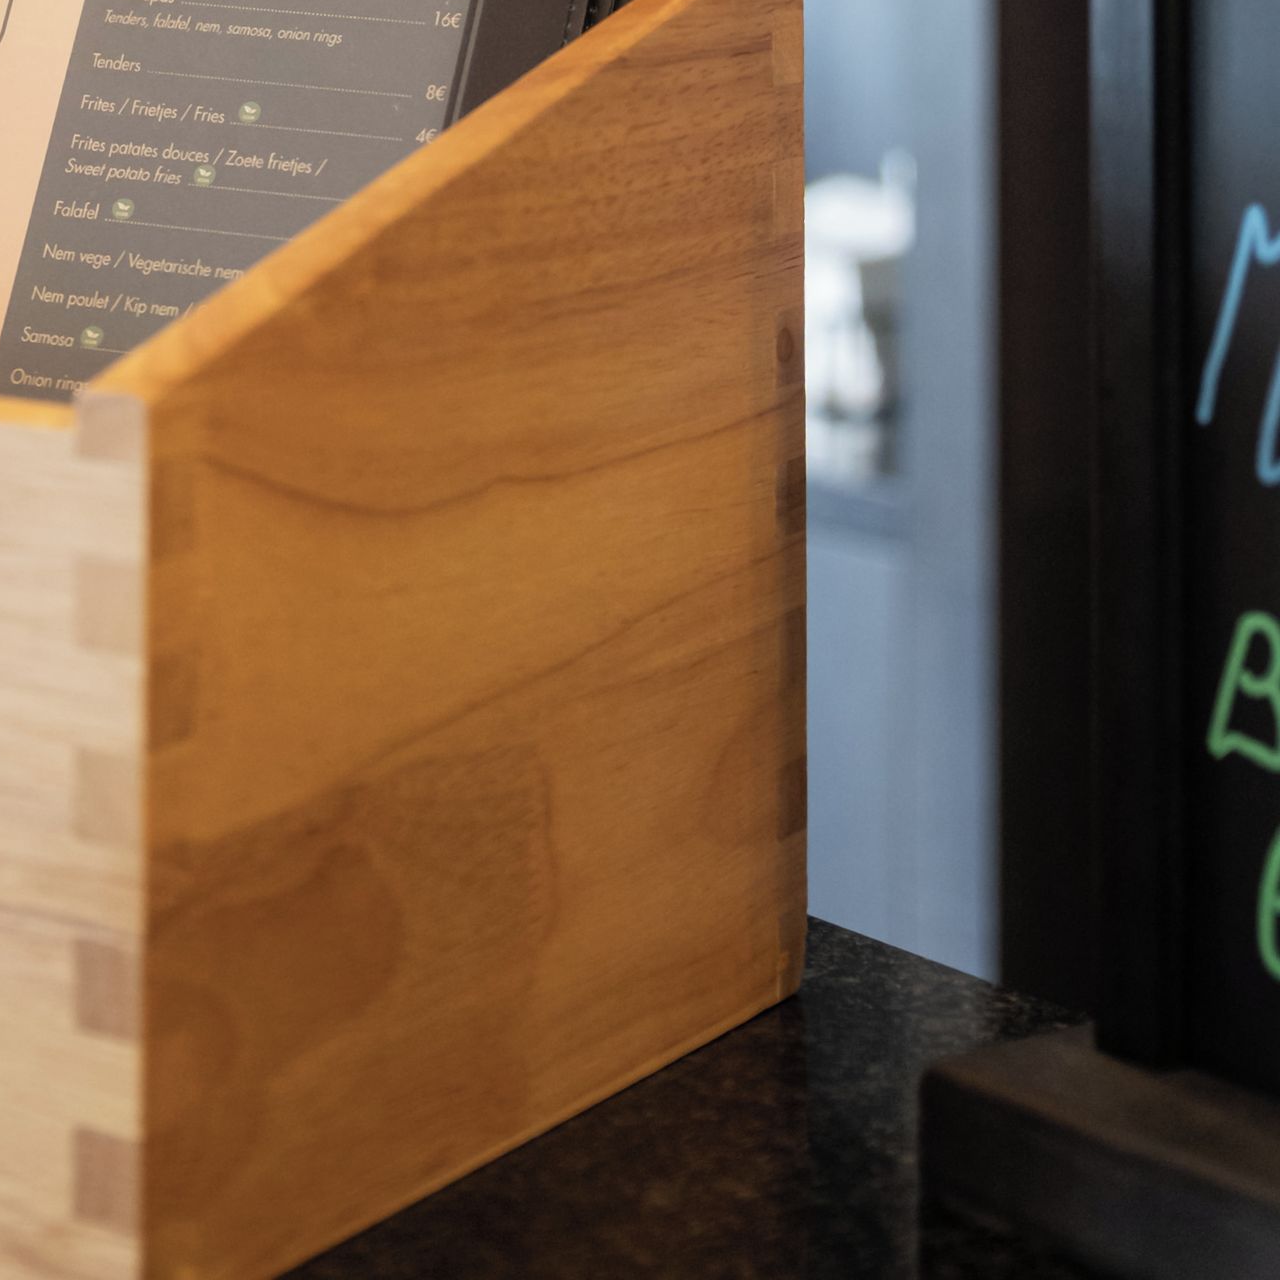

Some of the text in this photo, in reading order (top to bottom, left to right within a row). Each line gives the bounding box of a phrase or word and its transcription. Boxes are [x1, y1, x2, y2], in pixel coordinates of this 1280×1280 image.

[104, 10, 149, 28] Tenders,
[153, 13, 192, 33] falafel,
[227, 23, 273, 40] samosa,
[277, 26, 310, 42] onion
[313, 28, 343, 47] rings
[433, 10, 462, 29] 16€
[92, 52, 447, 102] Tenders 8€
[80, 94, 437, 144] Frites / Frietjes / Fries 4€
[70, 134, 328, 176] Frites patates douces / Zoete frietjes /
[64, 158, 182, 185] Sweet potato fries
[53, 200, 100, 220] Falafel
[42, 243, 76, 262] Nem
[79, 252, 112, 270] vege
[113, 250, 125, 268] /
[128, 253, 212, 278] Vegetarische
[31, 286, 65, 304] Nem
[67, 292, 109, 310] poulet
[110, 294, 124, 312] /
[124, 297, 148, 318] Kip
[150, 303, 179, 318] nem
[21, 326, 75, 348] Samosa
[10, 368, 53, 389] Onion
